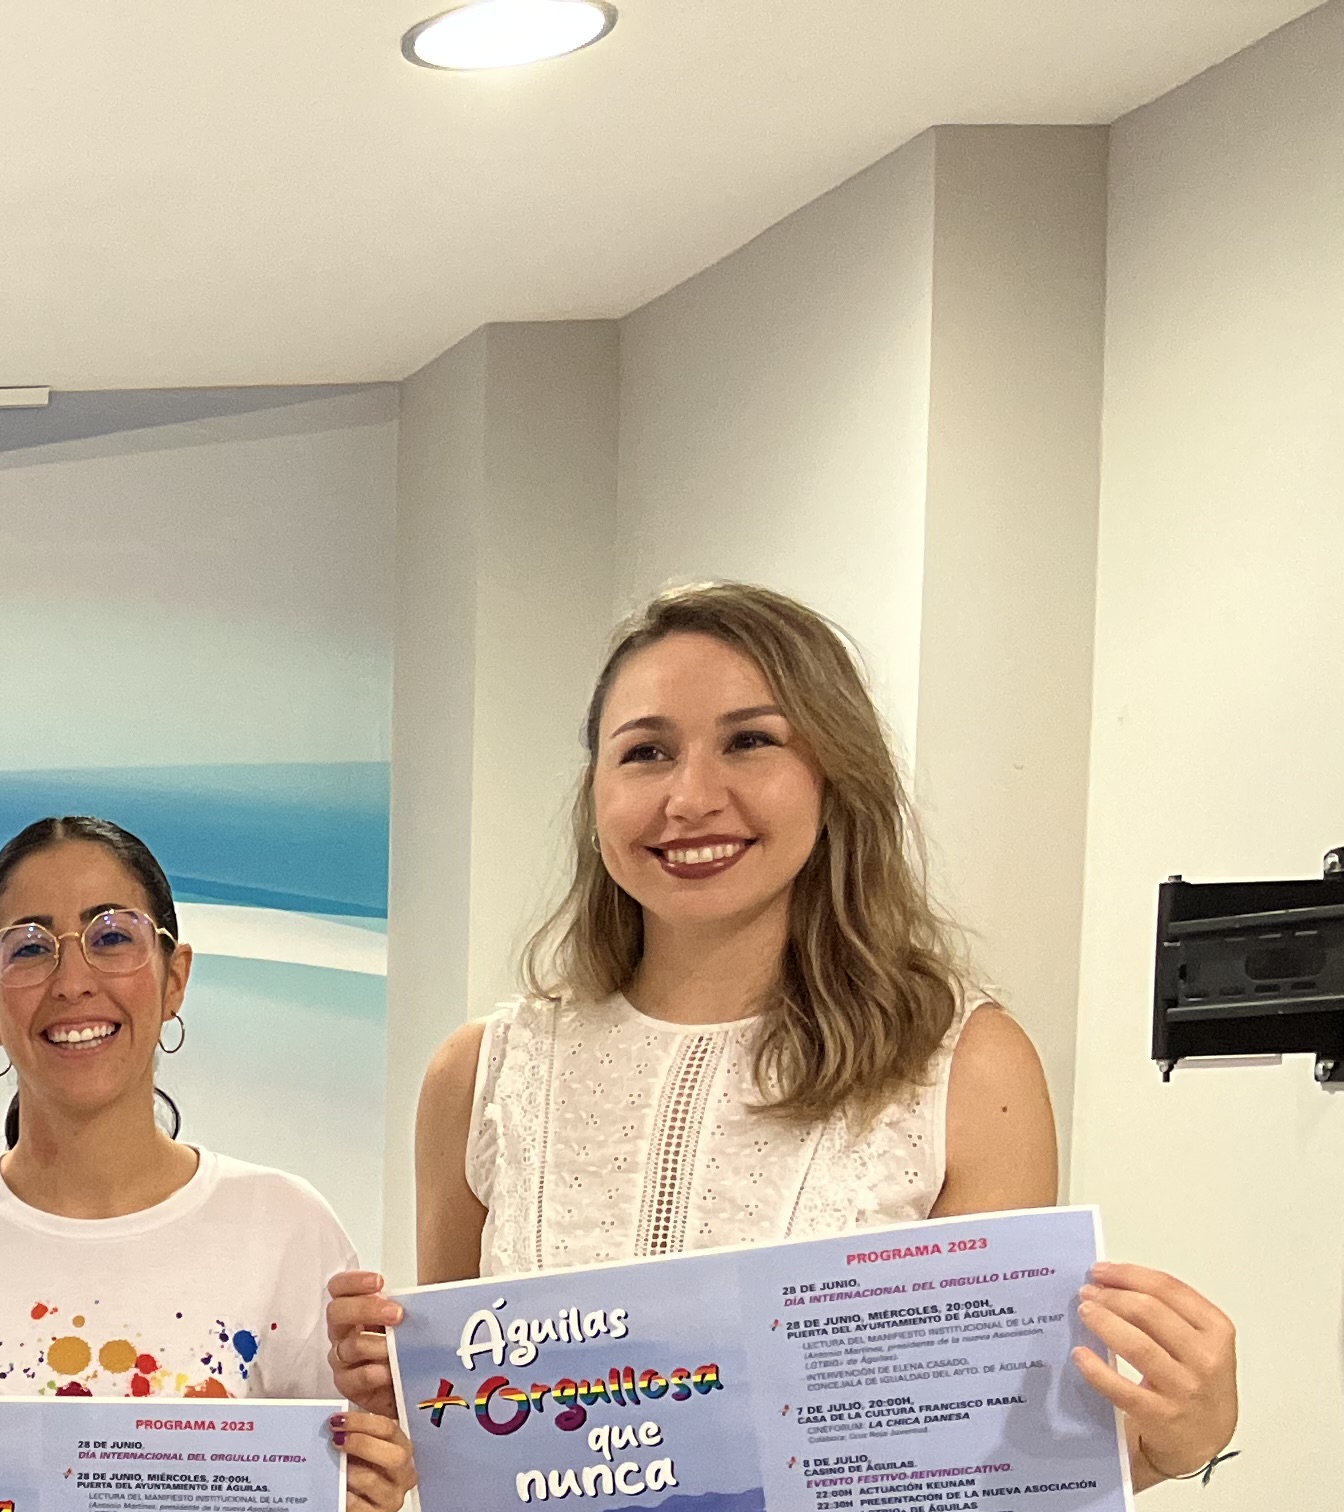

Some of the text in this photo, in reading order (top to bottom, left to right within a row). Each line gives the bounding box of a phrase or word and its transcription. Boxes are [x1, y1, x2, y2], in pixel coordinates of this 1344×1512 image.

[845, 1237, 987, 1265] PROGRAMA 2023
[781, 1285, 796, 1295] 28
[799, 1283, 816, 1293] DE
[783, 1294, 805, 1307] DÍA
[808, 1284, 907, 1304] INTERNACIONAL
[911, 1280, 935, 1292] DEL
[939, 1273, 1000, 1289] ORGULLO
[785, 1320, 800, 1330] 28
[803, 1318, 820, 1328] DE
[786, 1325, 828, 1340] PUERTA
[830, 1324, 852, 1334] DEL
[854, 1313, 942, 1332] AYUNTAMIENTO
[944, 1312, 960, 1322] DE
[456, 1297, 629, 1371] Águilas
[876, 1365, 891, 1374] DE
[892, 1361, 926, 1373] ELENA
[796, 1407, 803, 1415] 7
[806, 1405, 823, 1414] DE
[796, 1414, 827, 1424] CASA
[829, 1412, 845, 1421] DE
[847, 1411, 862, 1420] LA
[864, 1405, 916, 1418] CULTURA
[918, 1399, 983, 1413] FRANCISCO
[135, 1419, 254, 1431] PROGRAMA 2023
[868, 1420, 883, 1429] LA
[885, 1416, 920, 1427] CHICA
[922, 1411, 970, 1423] DANESA
[77, 1440, 90, 1448] 28
[587, 1421, 664, 1462] que
[78, 1449, 96, 1459] DÍA
[187, 1453, 207, 1461] DEL
[802, 1459, 810, 1468] 8
[813, 1457, 830, 1467] DE
[803, 1466, 845, 1477] CASINO
[847, 1464, 863, 1473] DE
[515, 1457, 679, 1503] nunca
[858, 1482, 923, 1495] ACTUACIÓN
[925, 1478, 975, 1490] KEUNAM
[859, 1492, 943, 1506] PRESENTACIÓN
[945, 1491, 961, 1500] DE
[963, 1489, 979, 1498] LA
[981, 1486, 1021, 1497] NUEVA
[1023, 1479, 1097, 1493] ASOCIACIÓN
